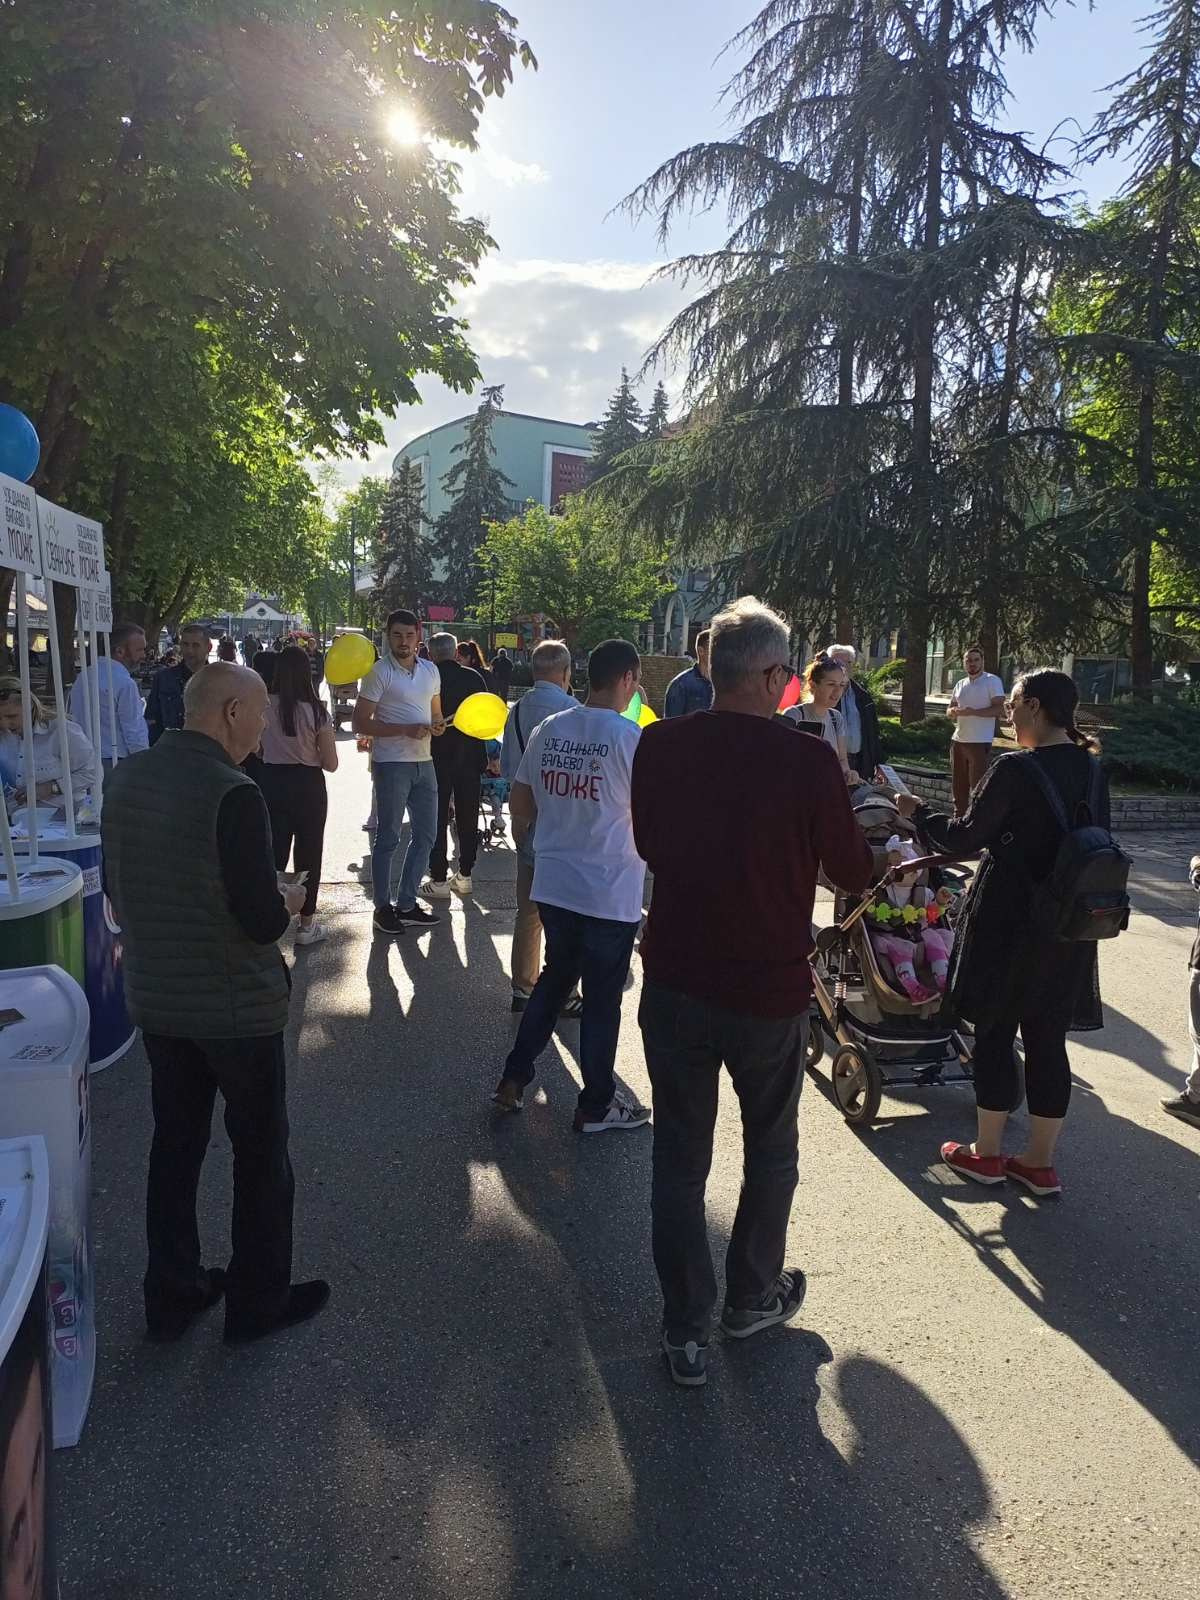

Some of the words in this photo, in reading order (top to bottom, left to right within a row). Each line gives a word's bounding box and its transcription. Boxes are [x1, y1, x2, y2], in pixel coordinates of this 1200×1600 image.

[7, 527, 35, 565] МОЖЕ
[79, 555, 99, 583] МОЖЕ
[541, 753, 584, 771] ВАЉЕВО
[541, 769, 603, 802] МОЖЕ
